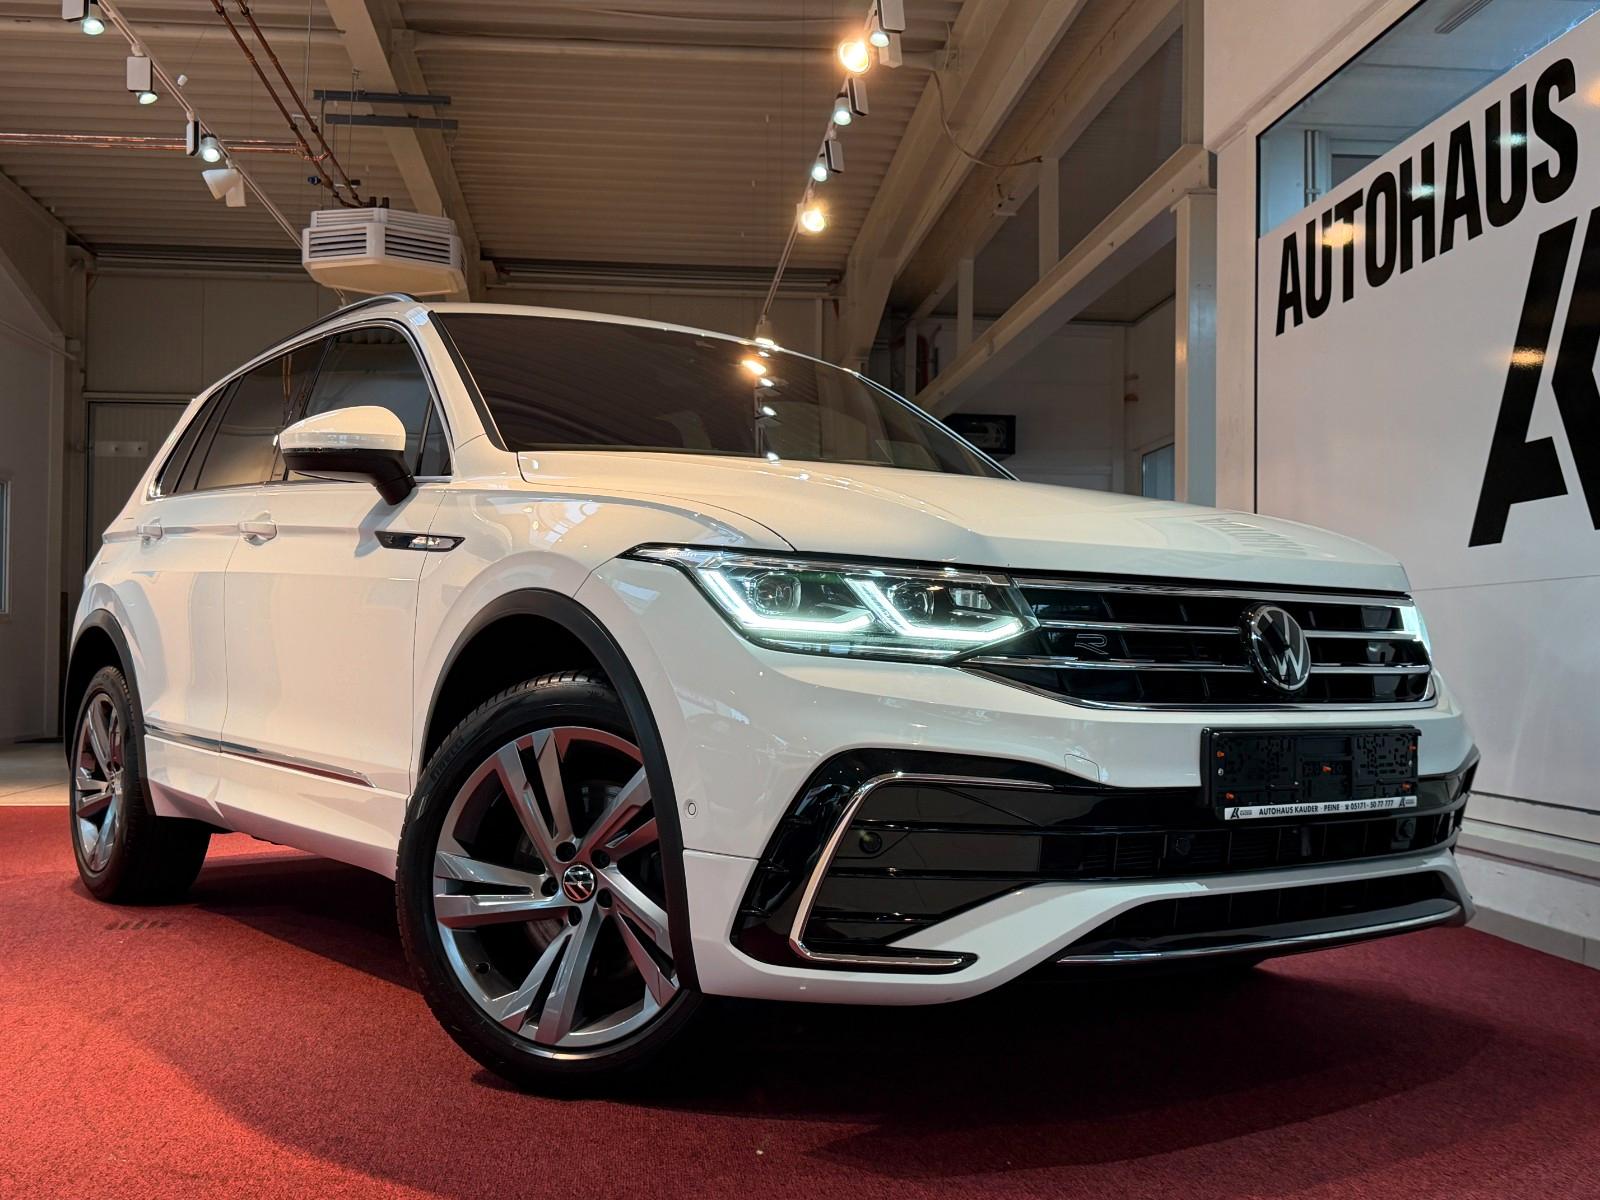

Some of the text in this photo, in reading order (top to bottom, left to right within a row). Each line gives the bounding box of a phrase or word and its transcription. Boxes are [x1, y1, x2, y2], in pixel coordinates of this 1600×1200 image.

[1275, 57, 1578, 337] AUTOHAUS
[1258, 806, 1293, 816] AUTOHAUS
[1294, 805, 1318, 814] KAUDER
[1323, 803, 1340, 812] PEINE
